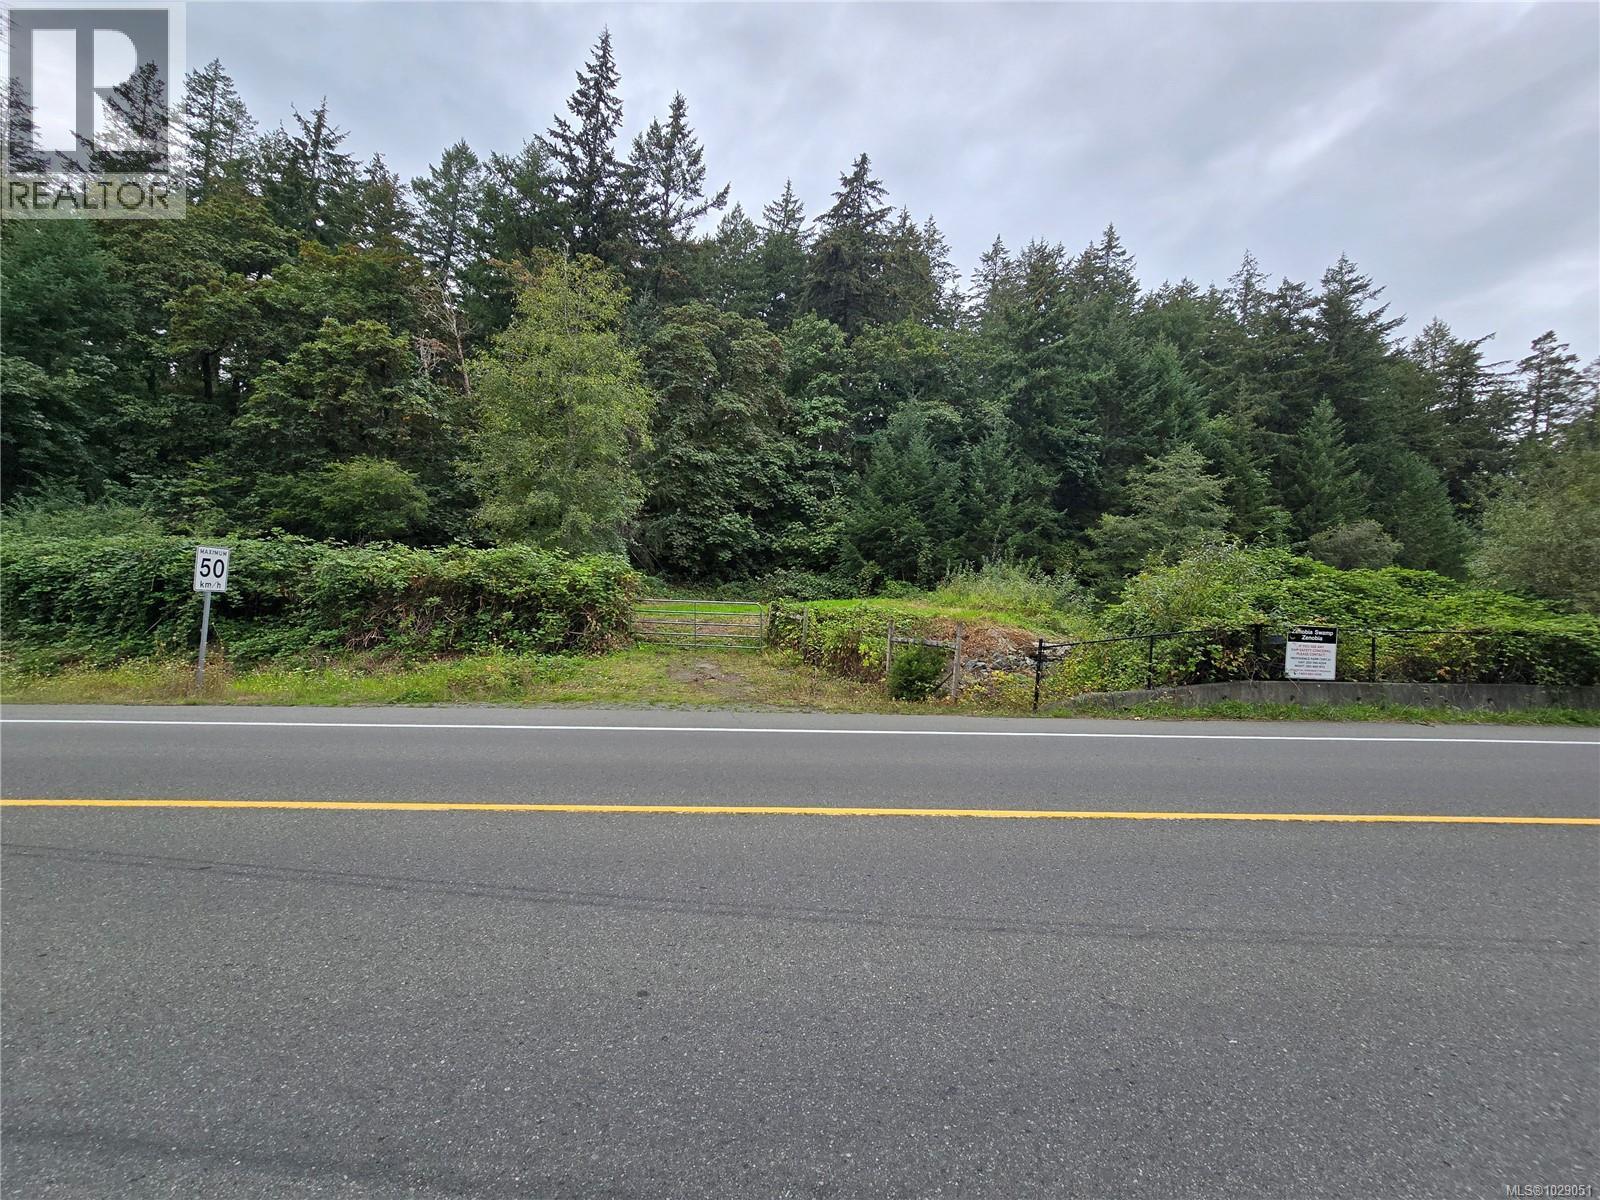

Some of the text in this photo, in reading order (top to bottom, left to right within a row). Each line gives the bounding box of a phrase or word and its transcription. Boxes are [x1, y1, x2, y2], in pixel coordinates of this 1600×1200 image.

[200, 548, 227, 556] MAXIMUM
[199, 558, 225, 579] 50
[199, 580, 222, 589] km/h
